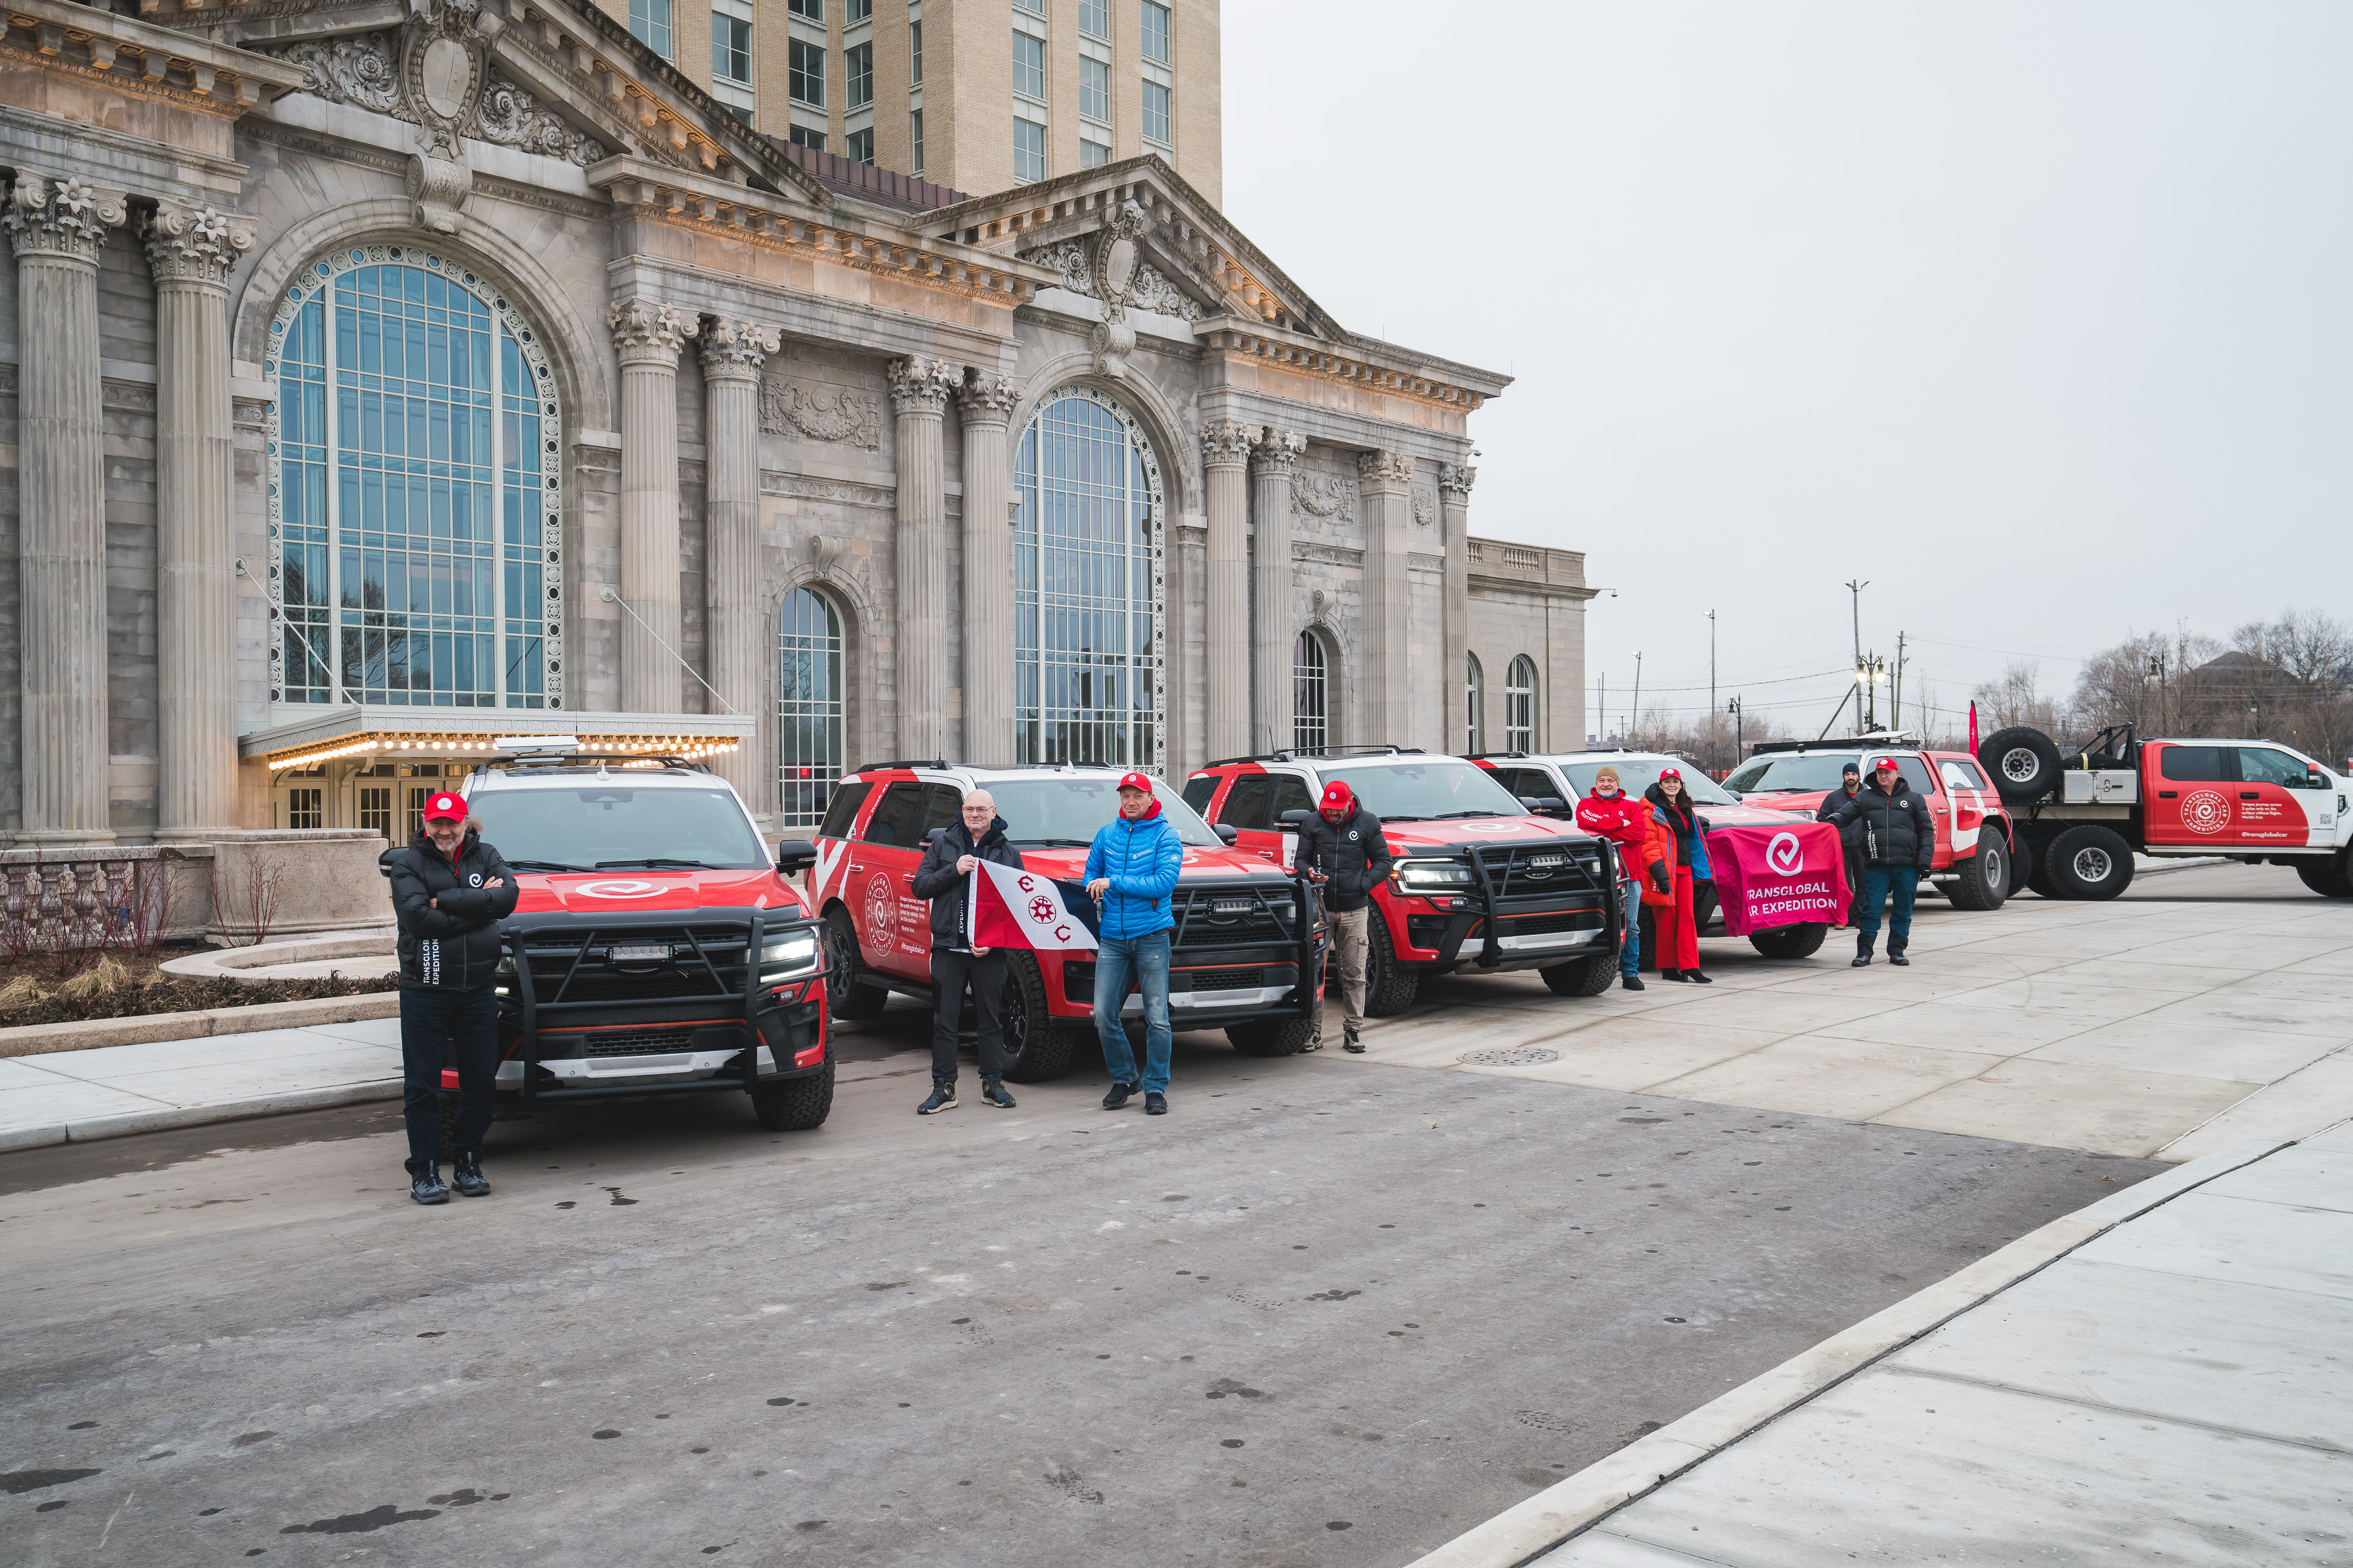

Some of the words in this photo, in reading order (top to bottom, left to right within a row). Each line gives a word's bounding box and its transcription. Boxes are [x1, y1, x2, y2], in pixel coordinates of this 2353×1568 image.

[1222, 785, 1231, 801] Truck
[871, 794, 882, 813] Truck
[2184, 793, 2222, 816] TRANSGLOBAL
[2186, 819, 2224, 832] EXPEDITION
[867, 878, 889, 919] TRANSGLOBAL
[1762, 898, 1837, 914] EXPEDITION
[870, 928, 894, 951] EXPEDITION
[1054, 924, 1071, 943] C
[901, 942, 925, 954] @transglobalcar
